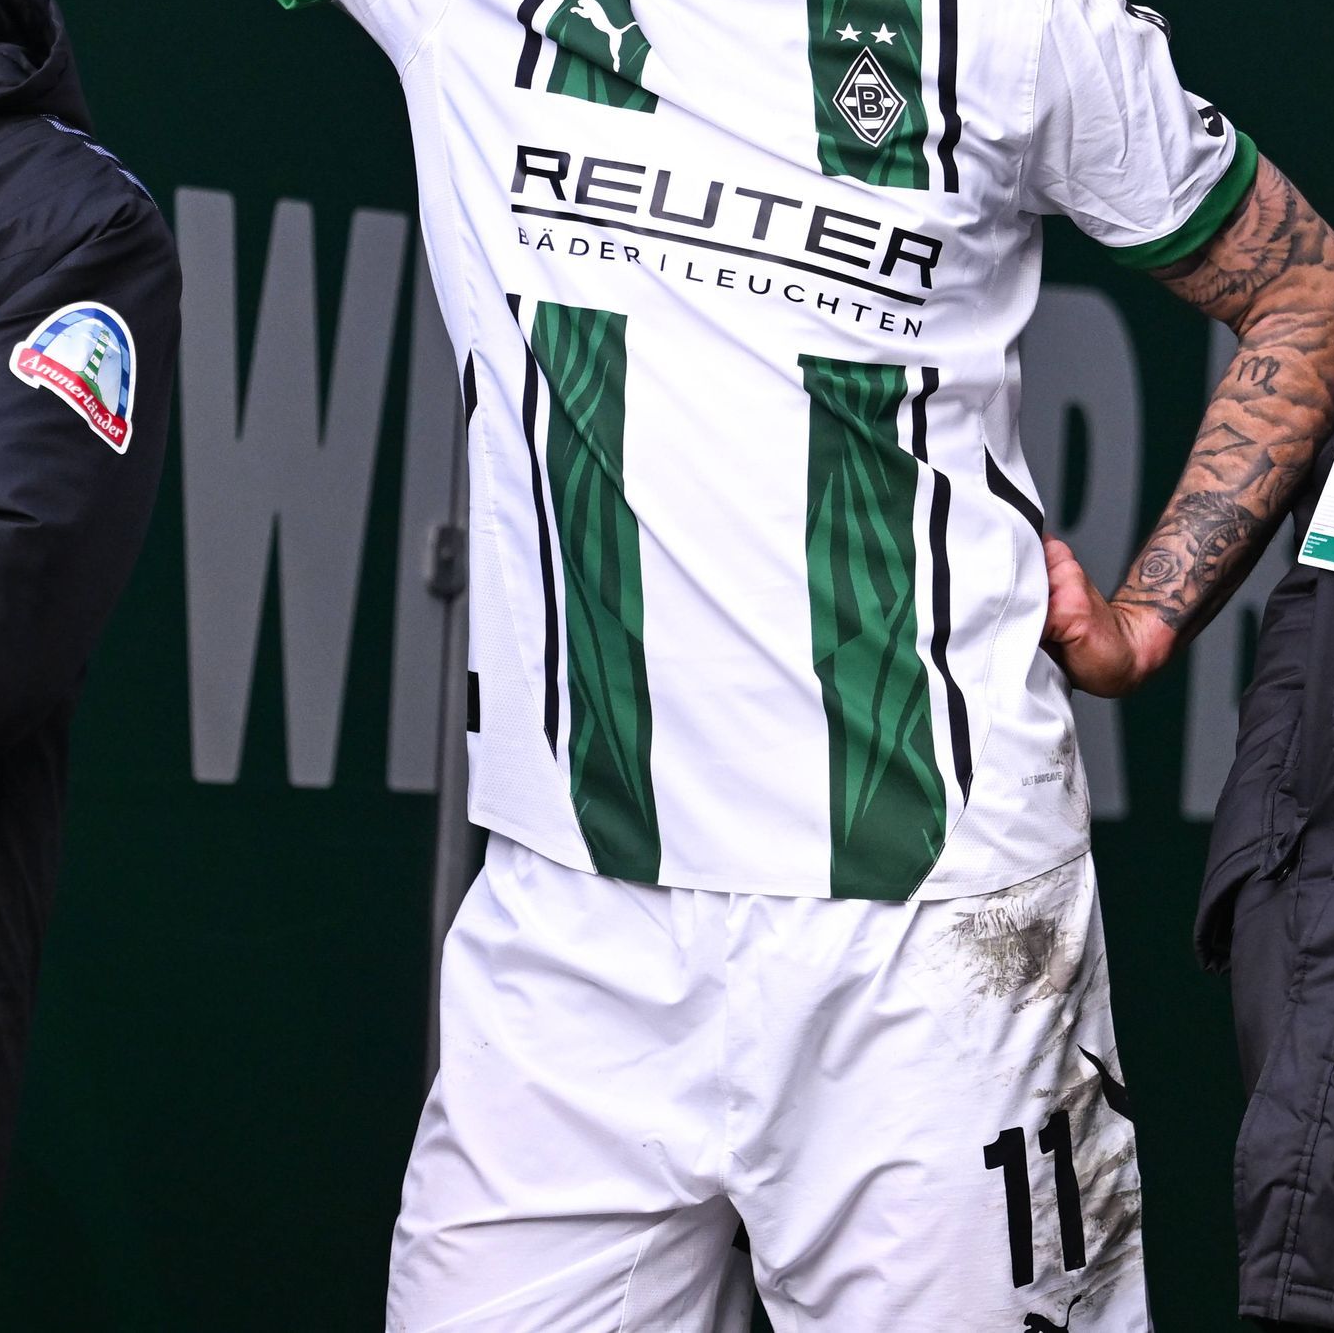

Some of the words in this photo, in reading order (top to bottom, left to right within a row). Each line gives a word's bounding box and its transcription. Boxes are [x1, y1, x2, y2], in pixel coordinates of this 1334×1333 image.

[510, 144, 943, 290] REUTER
[518, 226, 641, 265] BÄDER
[685, 261, 924, 338] LEUCHTEN
[20, 354, 123, 438] Ammerländer
[982, 1109, 1087, 1289] 11
